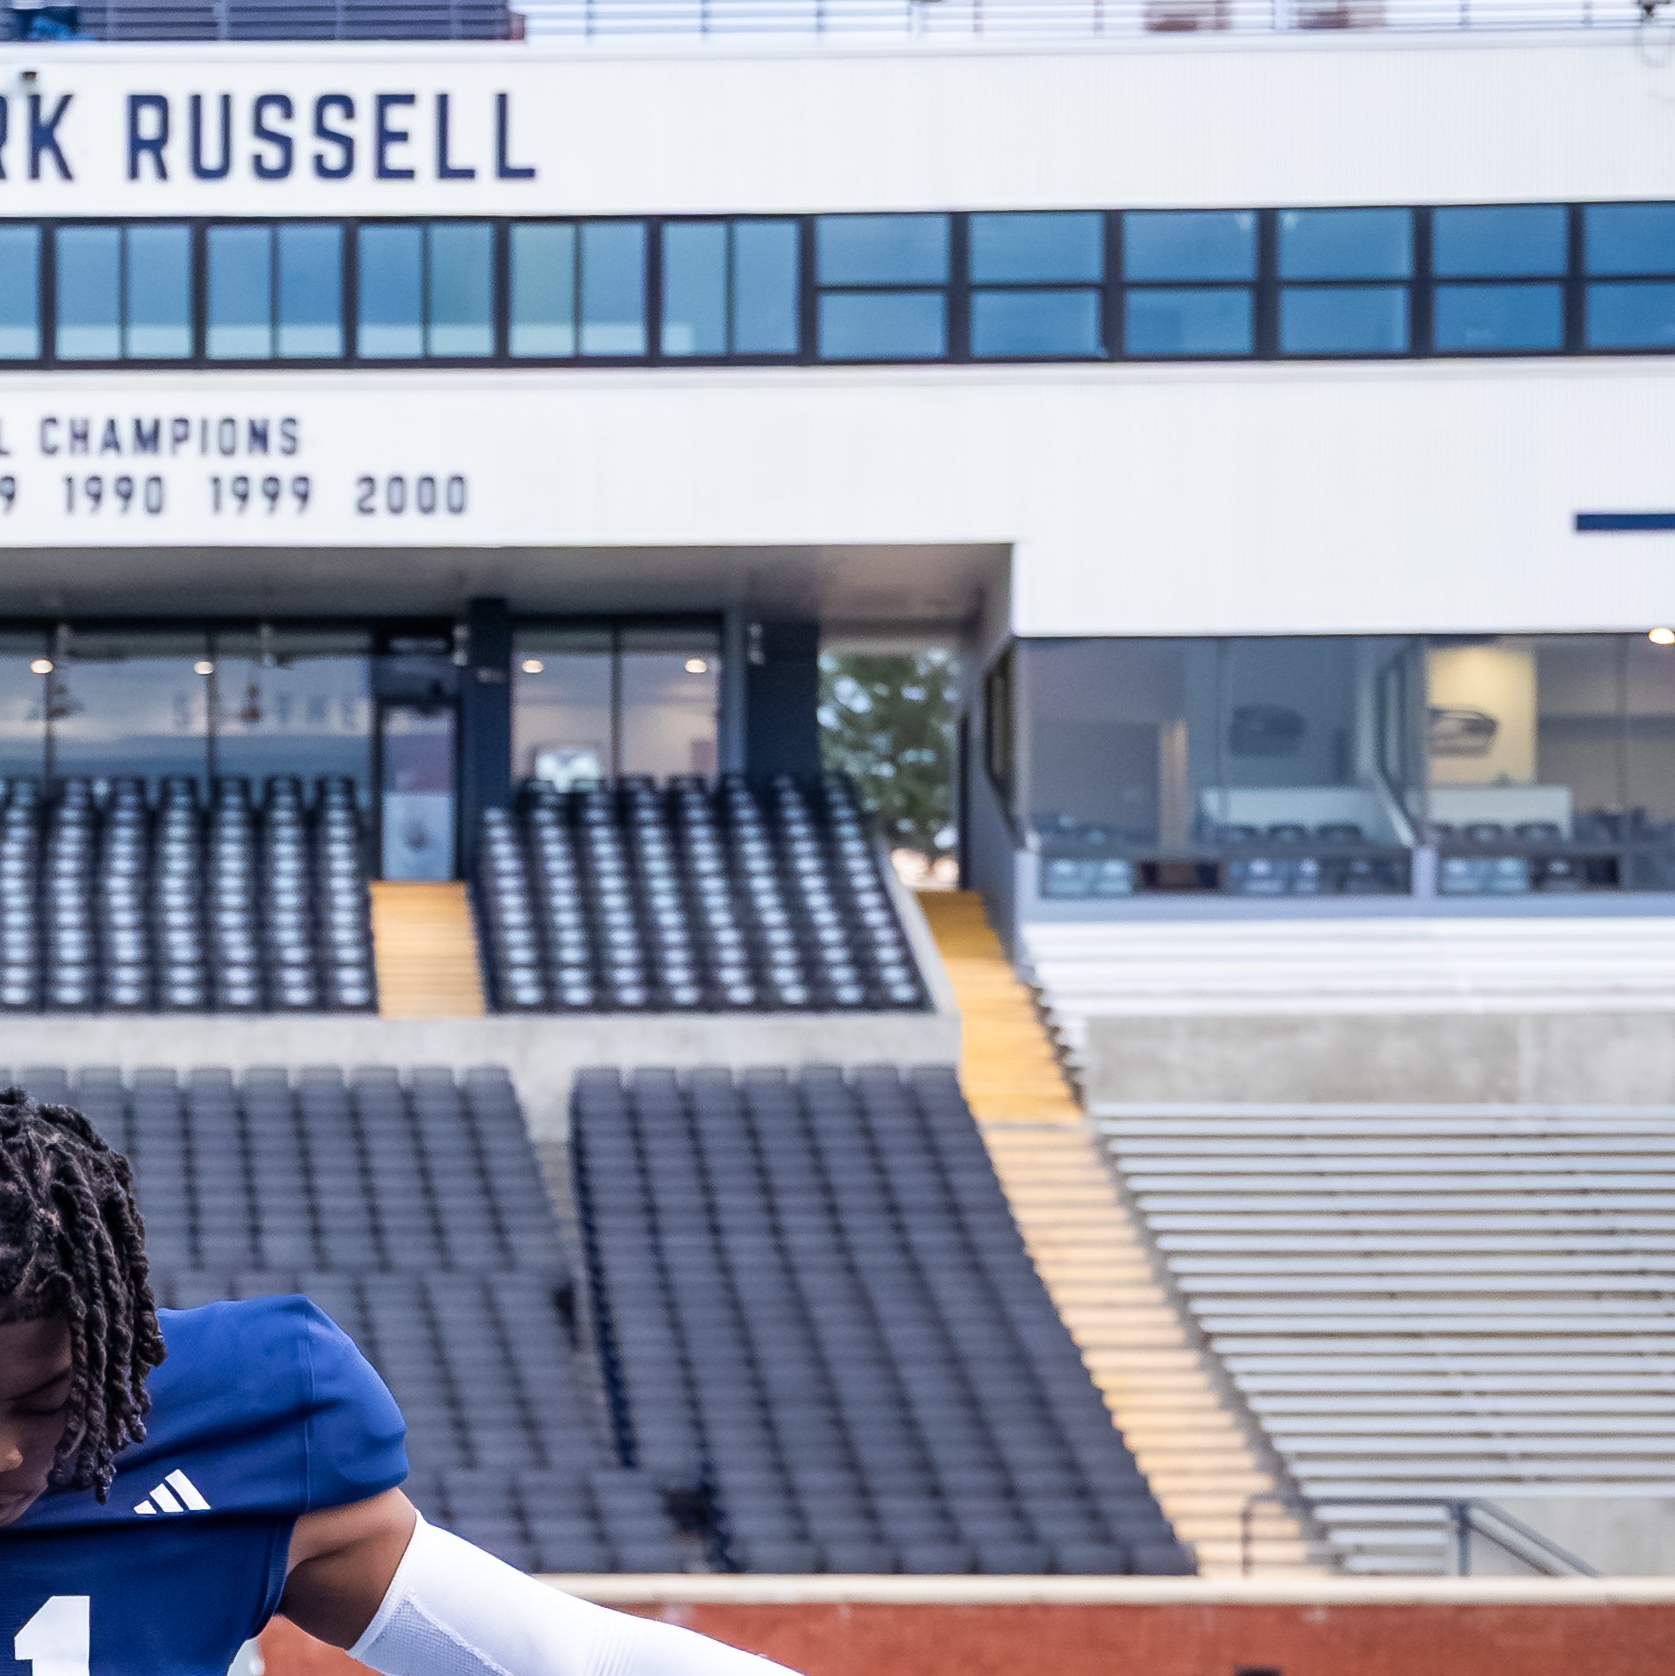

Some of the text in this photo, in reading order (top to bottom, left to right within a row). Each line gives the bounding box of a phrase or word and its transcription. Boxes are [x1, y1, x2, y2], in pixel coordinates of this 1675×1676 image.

[126, 92, 537, 182] RUSSELL
[39, 416, 300, 457] CHAMPIONS
[63, 473, 165, 516] 1990
[209, 473, 312, 516] 1999
[355, 473, 468, 516] 2000
